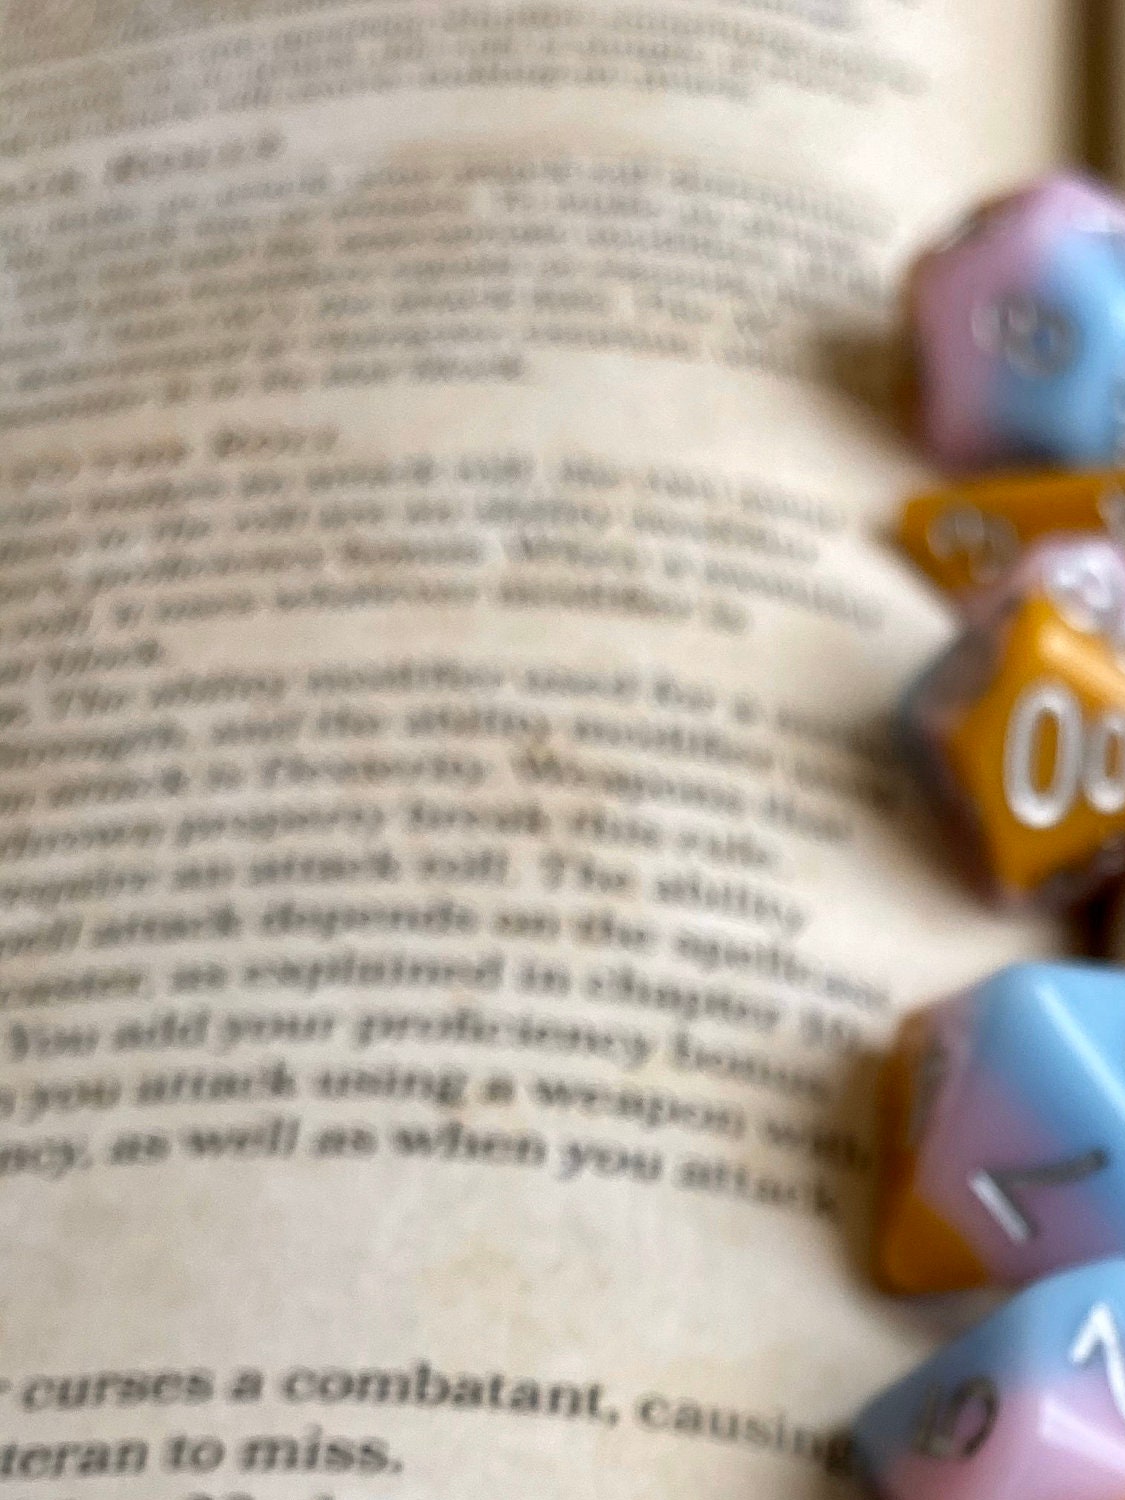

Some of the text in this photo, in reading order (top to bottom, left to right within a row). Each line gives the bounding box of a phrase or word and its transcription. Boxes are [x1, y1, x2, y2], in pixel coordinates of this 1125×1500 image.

[20, 1359, 620, 1427] curses combatant,
[165, 1423, 403, 1476] to miss.
